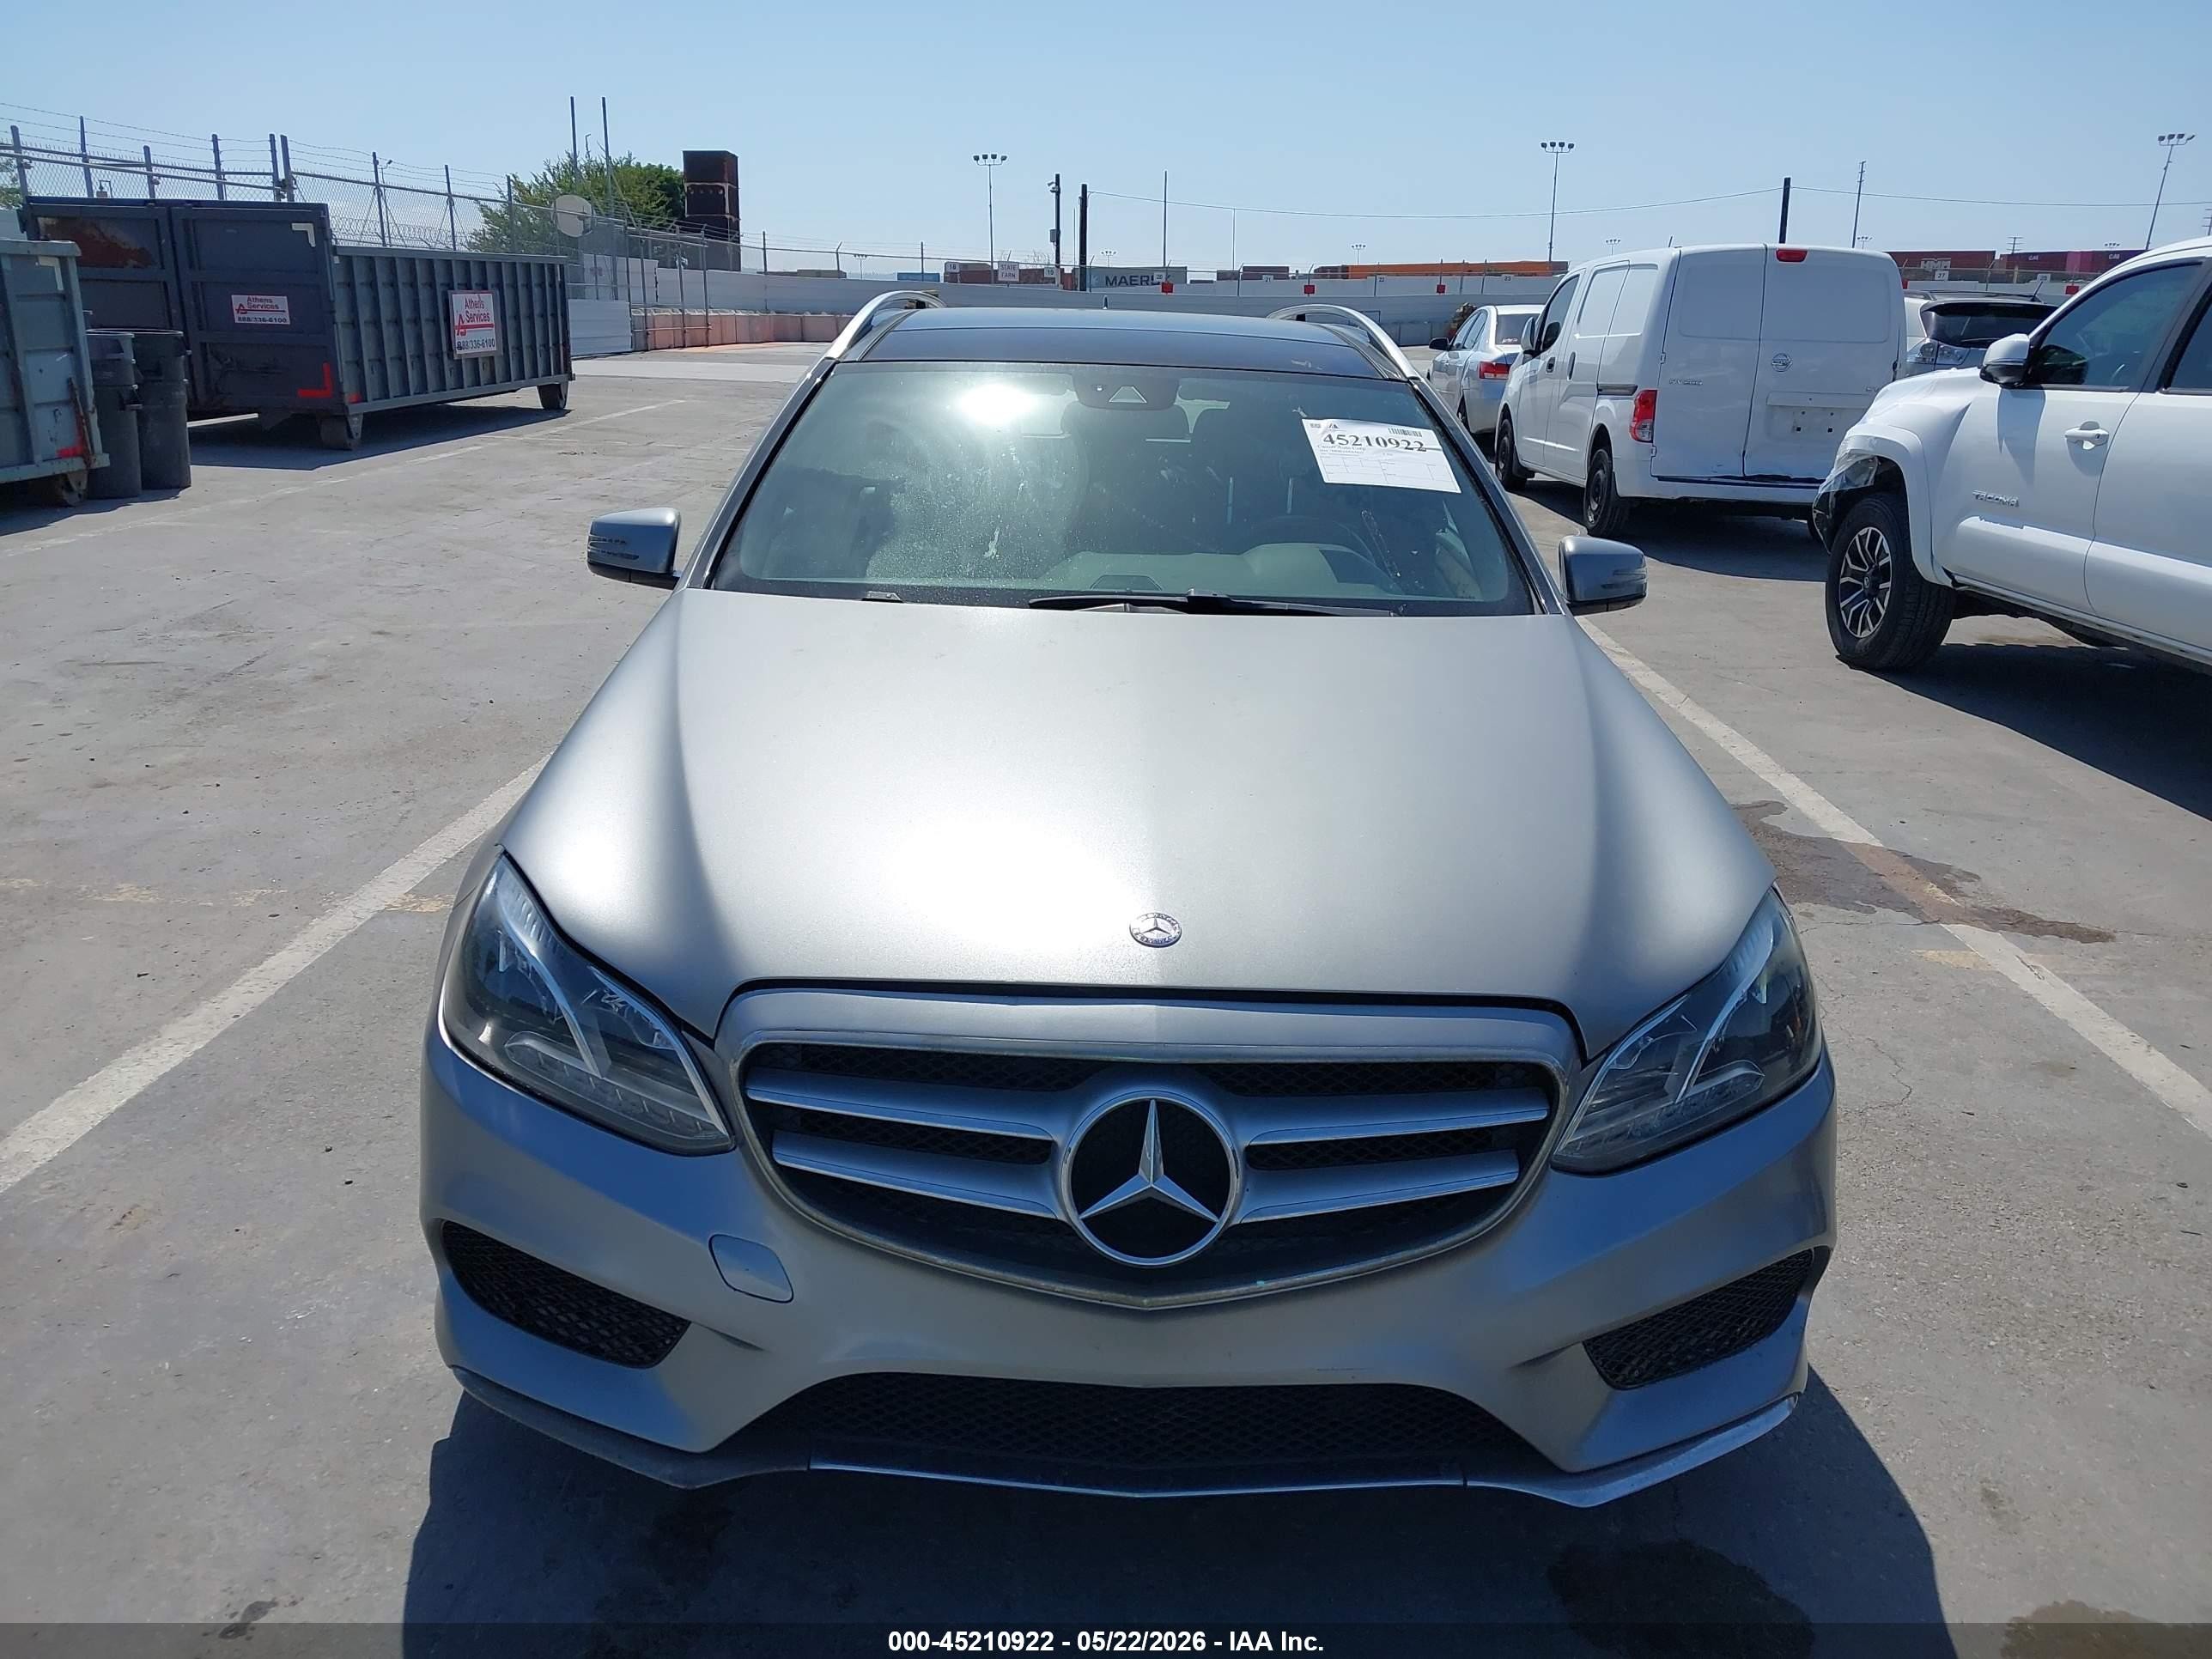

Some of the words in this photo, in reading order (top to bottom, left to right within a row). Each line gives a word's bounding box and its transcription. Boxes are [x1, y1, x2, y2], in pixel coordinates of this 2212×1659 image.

[1105, 275, 1171, 287] MAER
[246, 295, 273, 304] Athens
[465, 296, 485, 310] Athens
[465, 310, 490, 323] Services
[1322, 433, 1428, 453] 45210922
